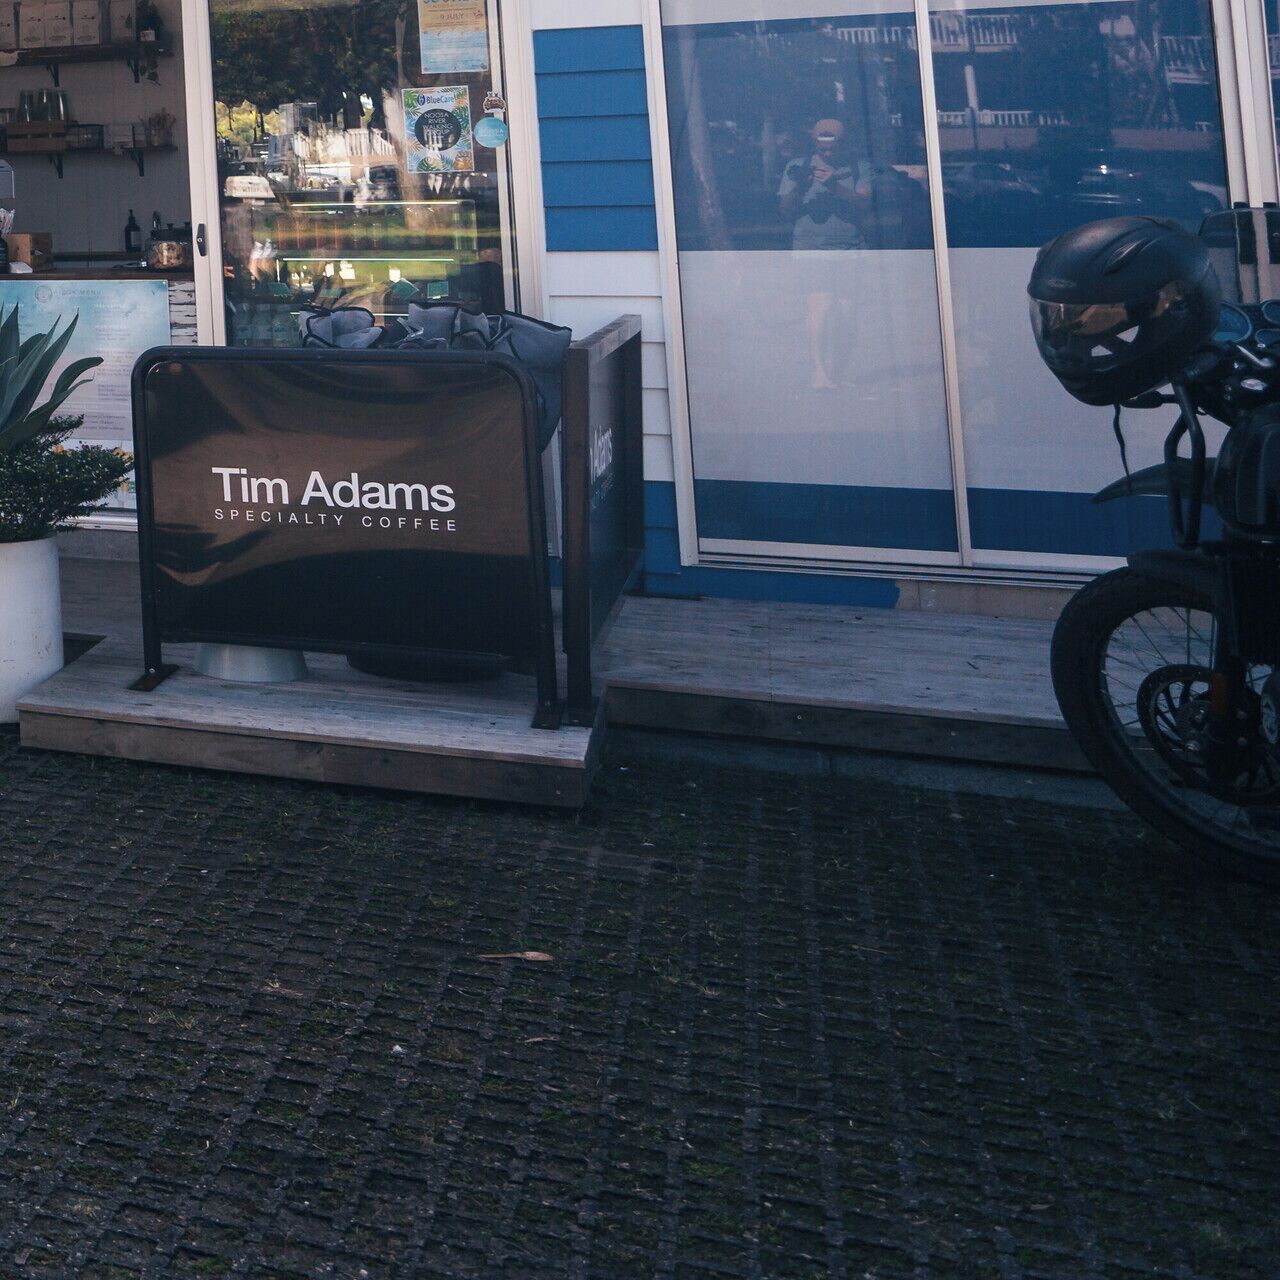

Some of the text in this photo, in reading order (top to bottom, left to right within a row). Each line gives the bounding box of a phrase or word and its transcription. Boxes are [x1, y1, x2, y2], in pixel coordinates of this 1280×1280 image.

[424, 111, 450, 119] NOOSA
[211, 466, 456, 512] Tim Adams
[214, 508, 457, 531] SPECIALTY COFFEE
